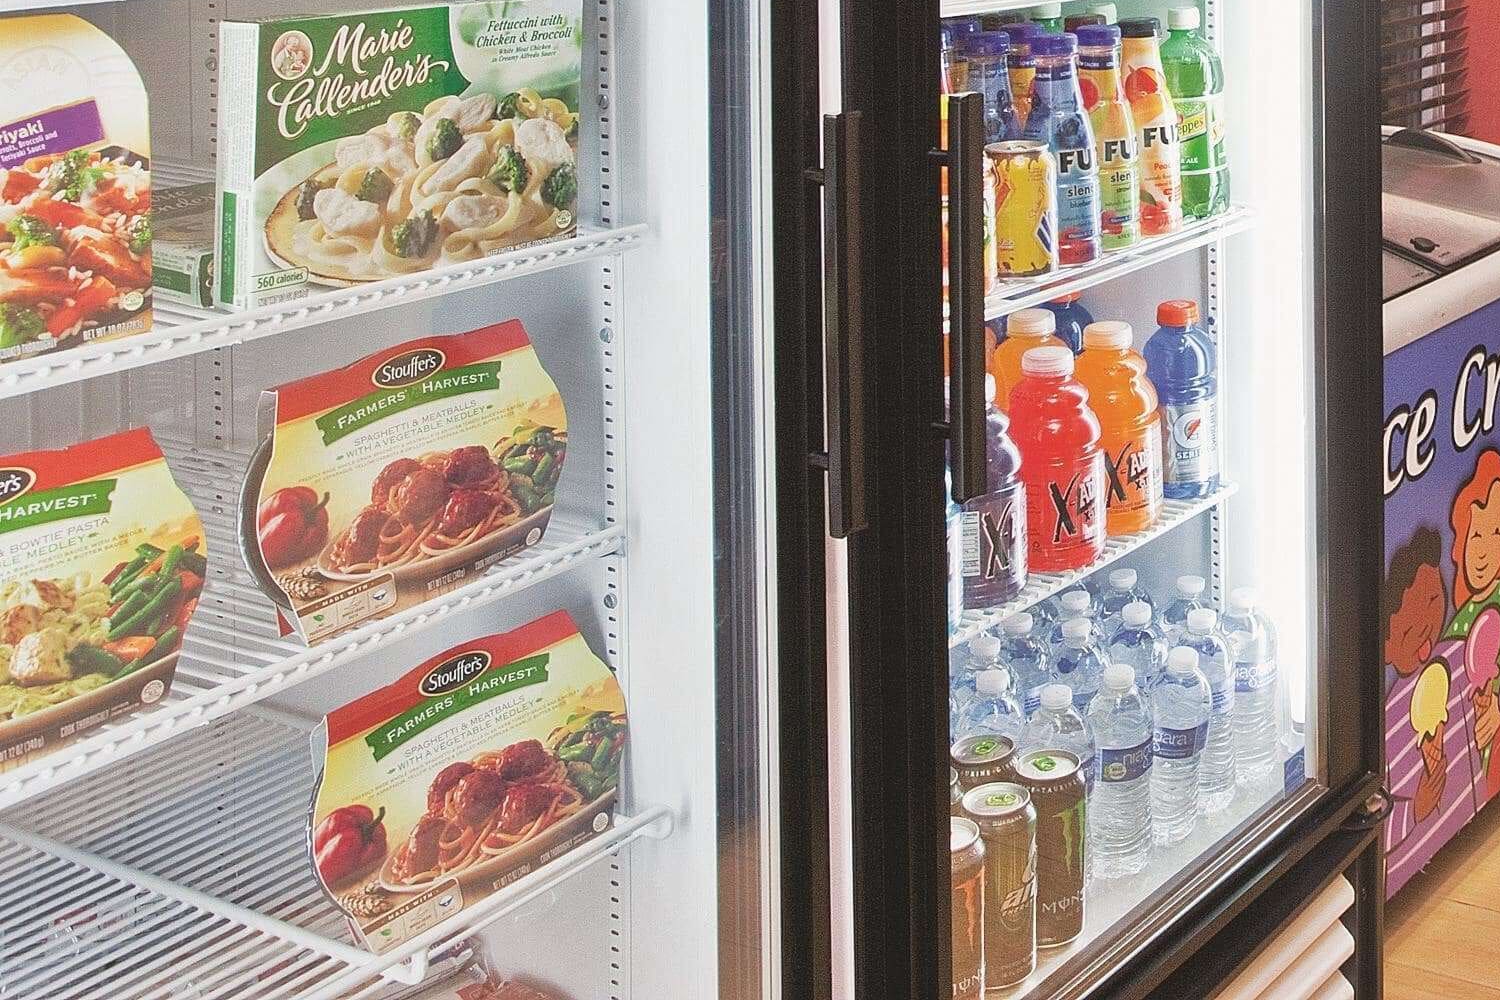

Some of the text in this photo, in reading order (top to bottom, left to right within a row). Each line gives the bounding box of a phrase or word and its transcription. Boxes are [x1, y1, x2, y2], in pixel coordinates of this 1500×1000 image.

[313, 18, 414, 76] Marie
[476, 27, 572, 49] Chicken & Broccoli
[487, 14, 563, 32] Fettuccini with
[266, 53, 450, 140] Callender's
[257, 269, 304, 290] 560 calories
[381, 353, 437, 383] Stouffer's
[337, 372, 488, 429] FARMERS' HARVEST
[353, 422, 410, 447] SPAGHETTI
[421, 399, 477, 424] MEATBALLS
[345, 444, 372, 458] WITH
[381, 421, 443, 447] VEGETABLE
[445, 406, 486, 425] MEDLEY
[1383, 386, 1439, 497] ce
[67, 517, 111, 535] PASTA
[427, 656, 483, 691] Stouffer's
[387, 667, 533, 744] FARMERS' HARVEST
[403, 727, 461, 758] SPAGHETTI
[470, 696, 526, 725] MEATBALLS
[396, 754, 424, 772] WITH
[433, 721, 494, 753] VEGETABLE
[494, 700, 535, 725] MEDLEY
